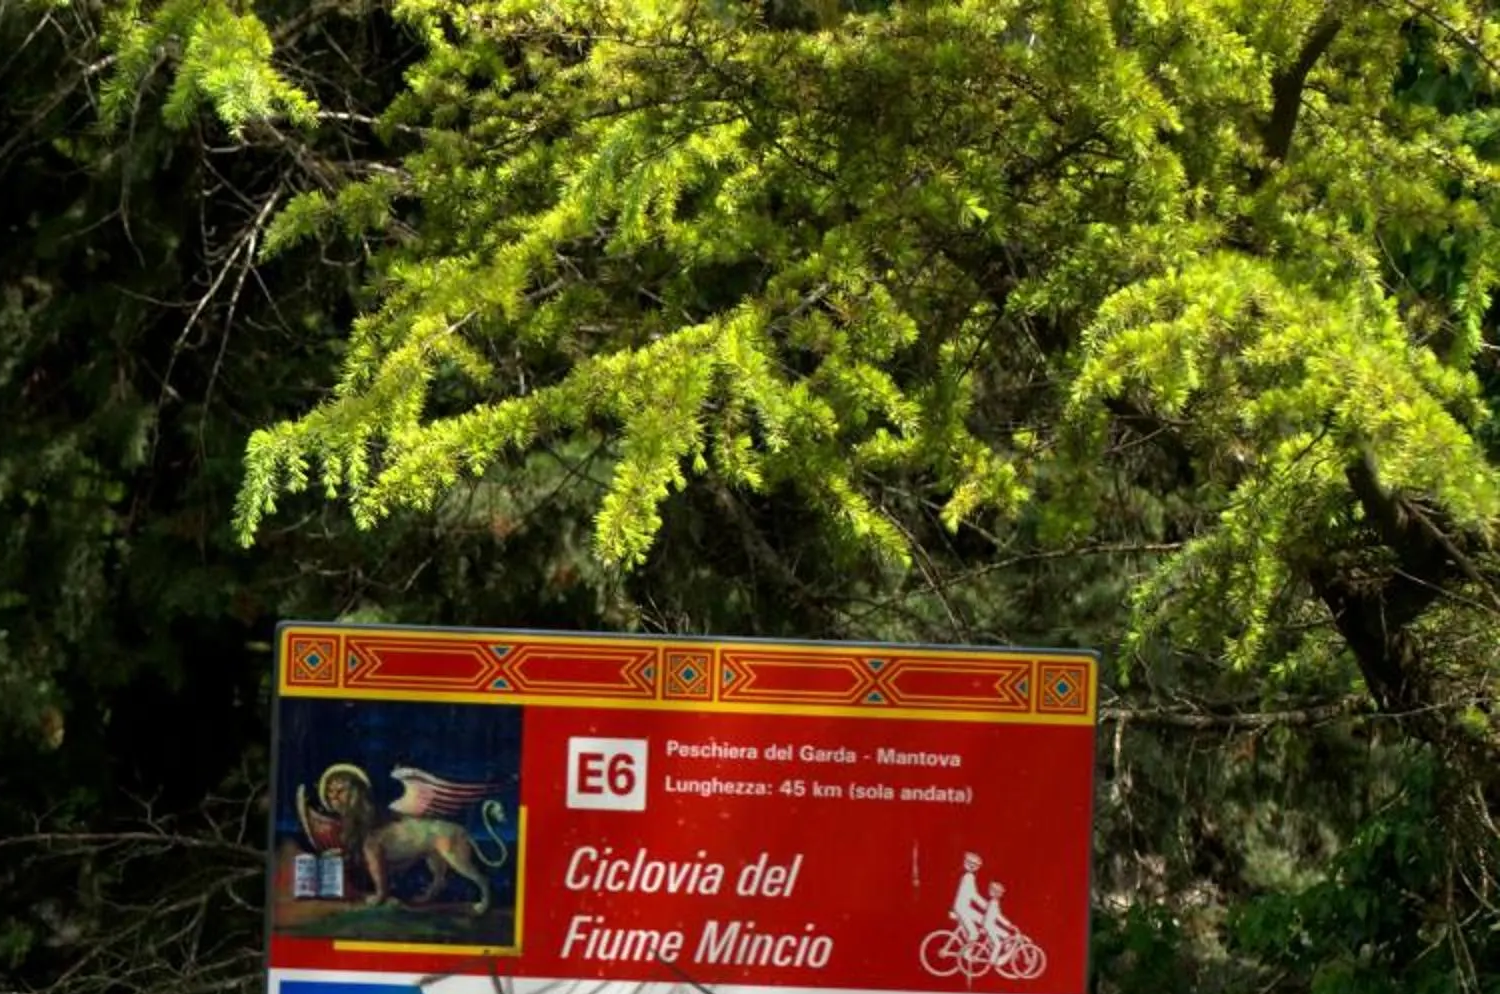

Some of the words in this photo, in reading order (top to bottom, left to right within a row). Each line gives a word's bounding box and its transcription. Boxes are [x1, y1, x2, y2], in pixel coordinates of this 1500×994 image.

[576, 752, 636, 796] E6
[666, 739, 758, 761] Peschiera
[764, 743, 792, 761] del
[799, 745, 856, 764] Garda
[877, 747, 961, 768] Mantova
[665, 775, 772, 799] Lunghezza:
[779, 779, 805, 797] 45
[812, 781, 842, 798] km
[850, 783, 894, 802] (sola
[900, 785, 972, 805] andata)
[565, 845, 725, 894] Ciclovia
[737, 852, 804, 898] del
[561, 915, 683, 963] Fiume
[694, 920, 833, 969] Mincio
